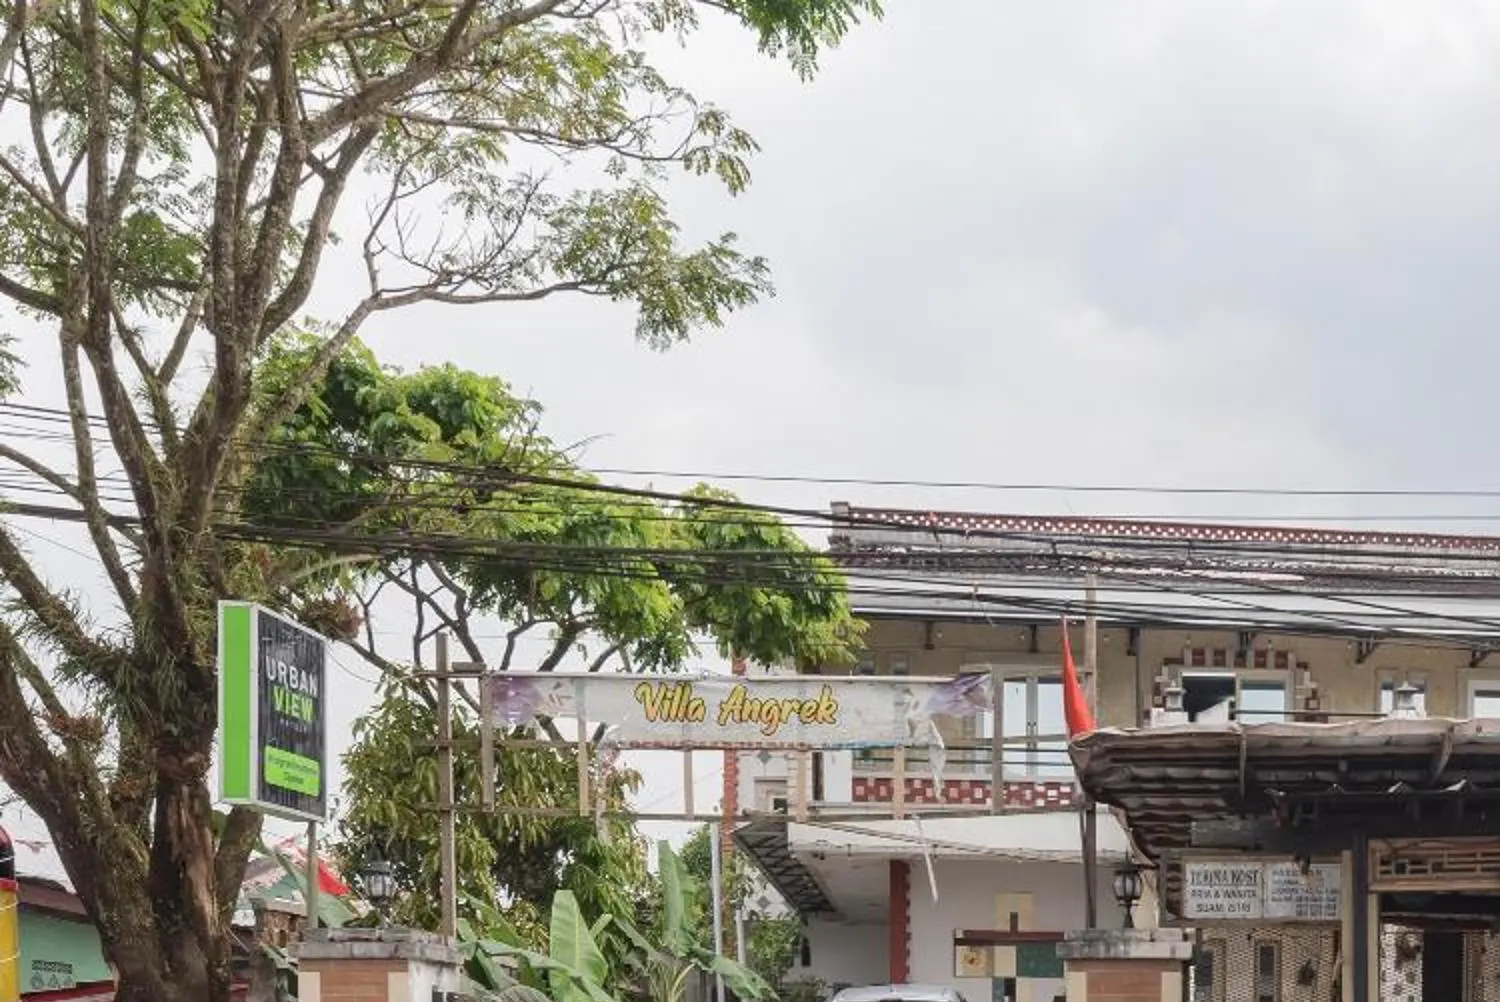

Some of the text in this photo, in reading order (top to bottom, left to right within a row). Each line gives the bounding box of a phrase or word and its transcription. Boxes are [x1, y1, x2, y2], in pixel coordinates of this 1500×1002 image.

[266, 656, 318, 698] URBAN
[273, 685, 314, 722] VIEW
[634, 681, 838, 737] Villa Angrek
